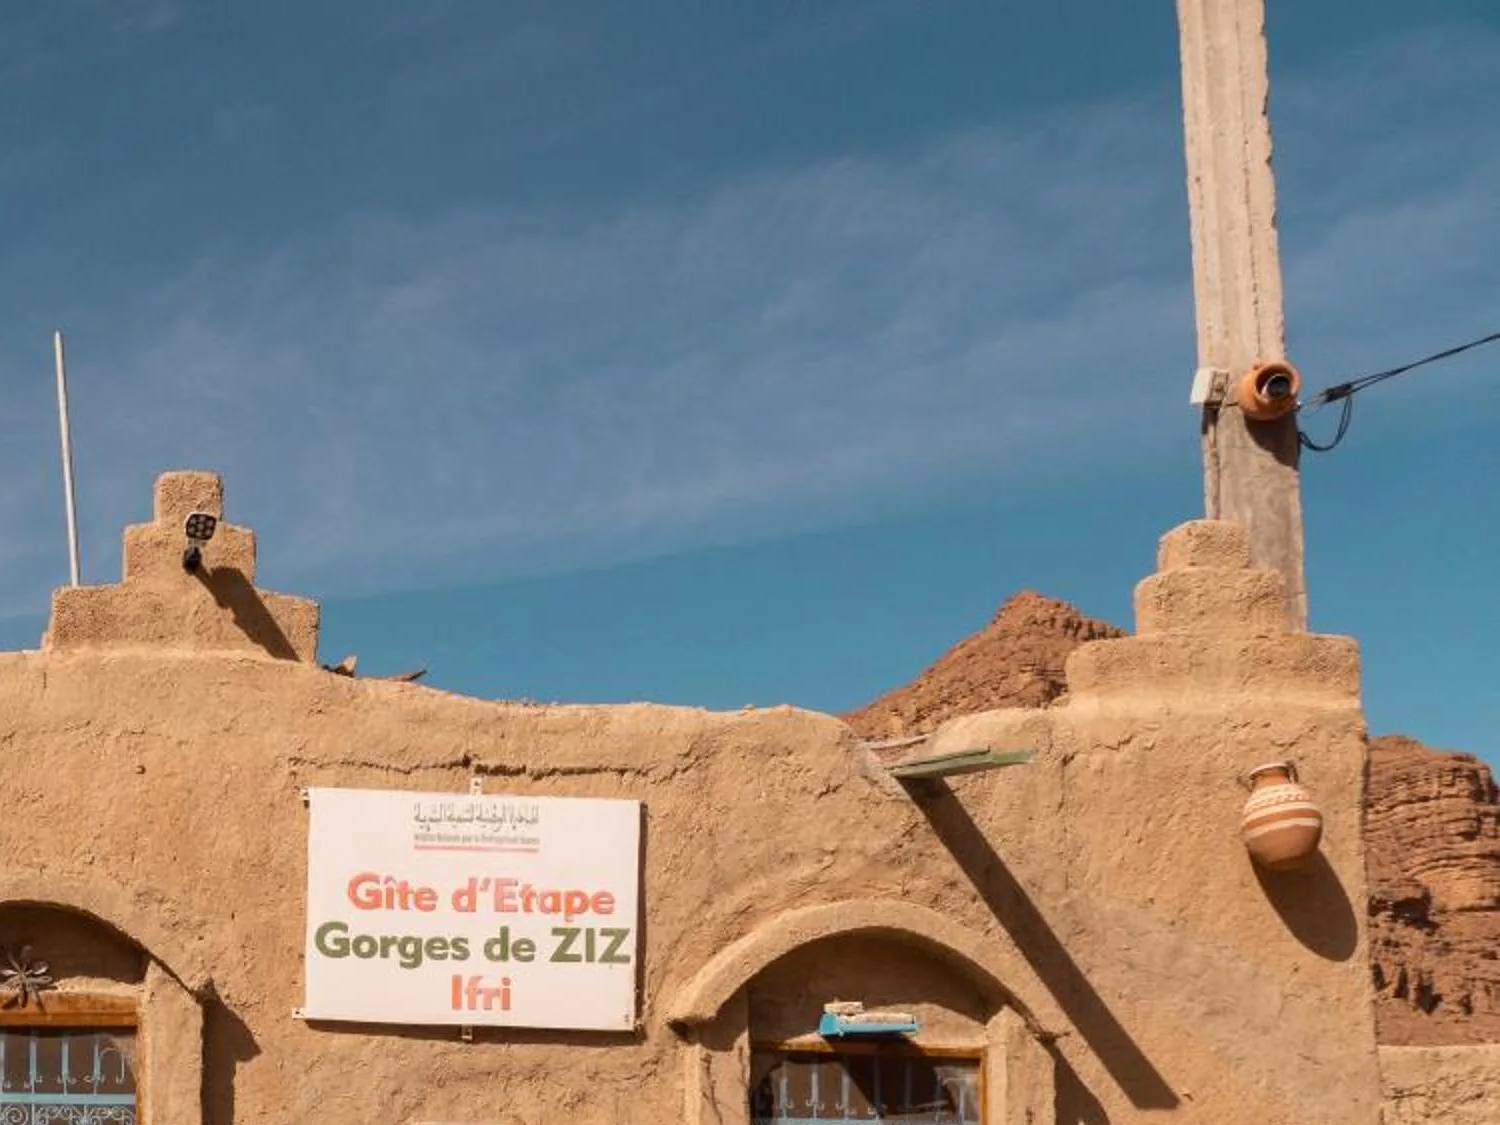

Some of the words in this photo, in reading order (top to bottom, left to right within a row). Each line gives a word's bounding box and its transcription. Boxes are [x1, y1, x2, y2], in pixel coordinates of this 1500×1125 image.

[347, 872, 438, 912] Gîte
[451, 877, 615, 922] d'Etape
[314, 921, 470, 968] Gorges
[483, 926, 536, 962] de
[549, 928, 631, 963] ZIZ
[451, 974, 512, 1011] Ifri
